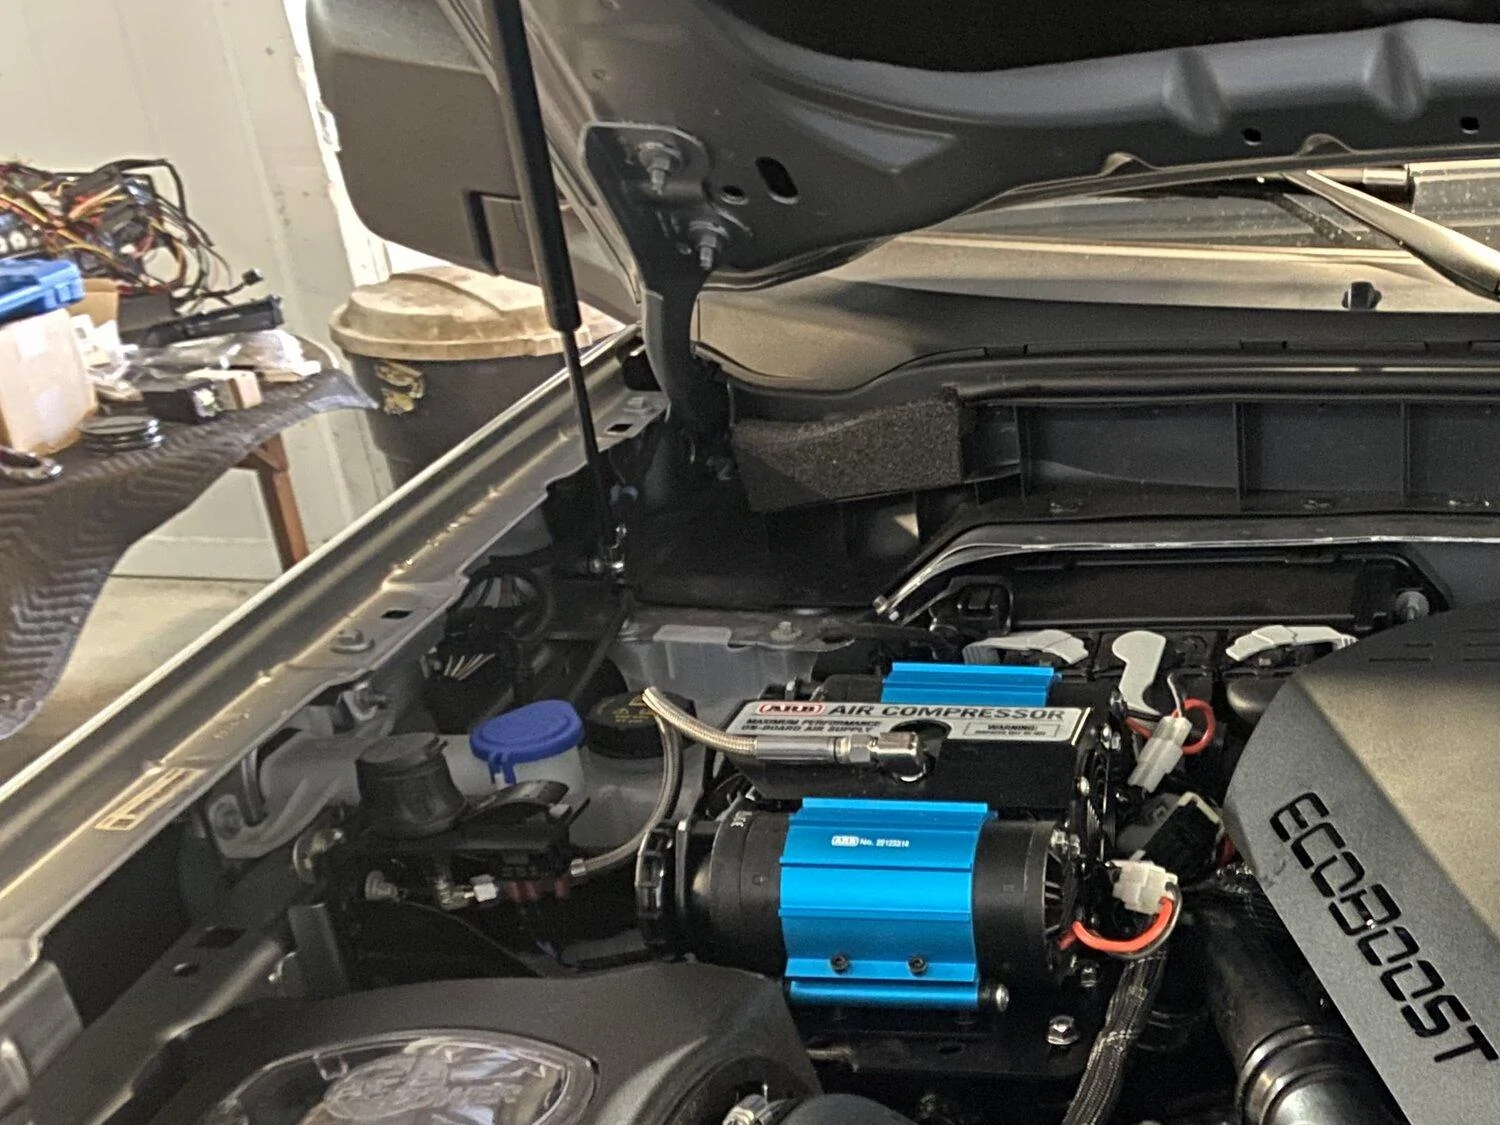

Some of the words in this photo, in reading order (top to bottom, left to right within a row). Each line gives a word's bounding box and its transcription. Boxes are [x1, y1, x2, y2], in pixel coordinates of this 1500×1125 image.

[763, 703, 819, 714] ARB
[829, 705, 875, 717] AIR
[882, 706, 1065, 721] COMPRESSOR
[741, 724, 801, 732] ON-BOARD
[801, 719, 882, 727] PERFORMANCE
[1270, 792, 1498, 1063] ECOBOOST
